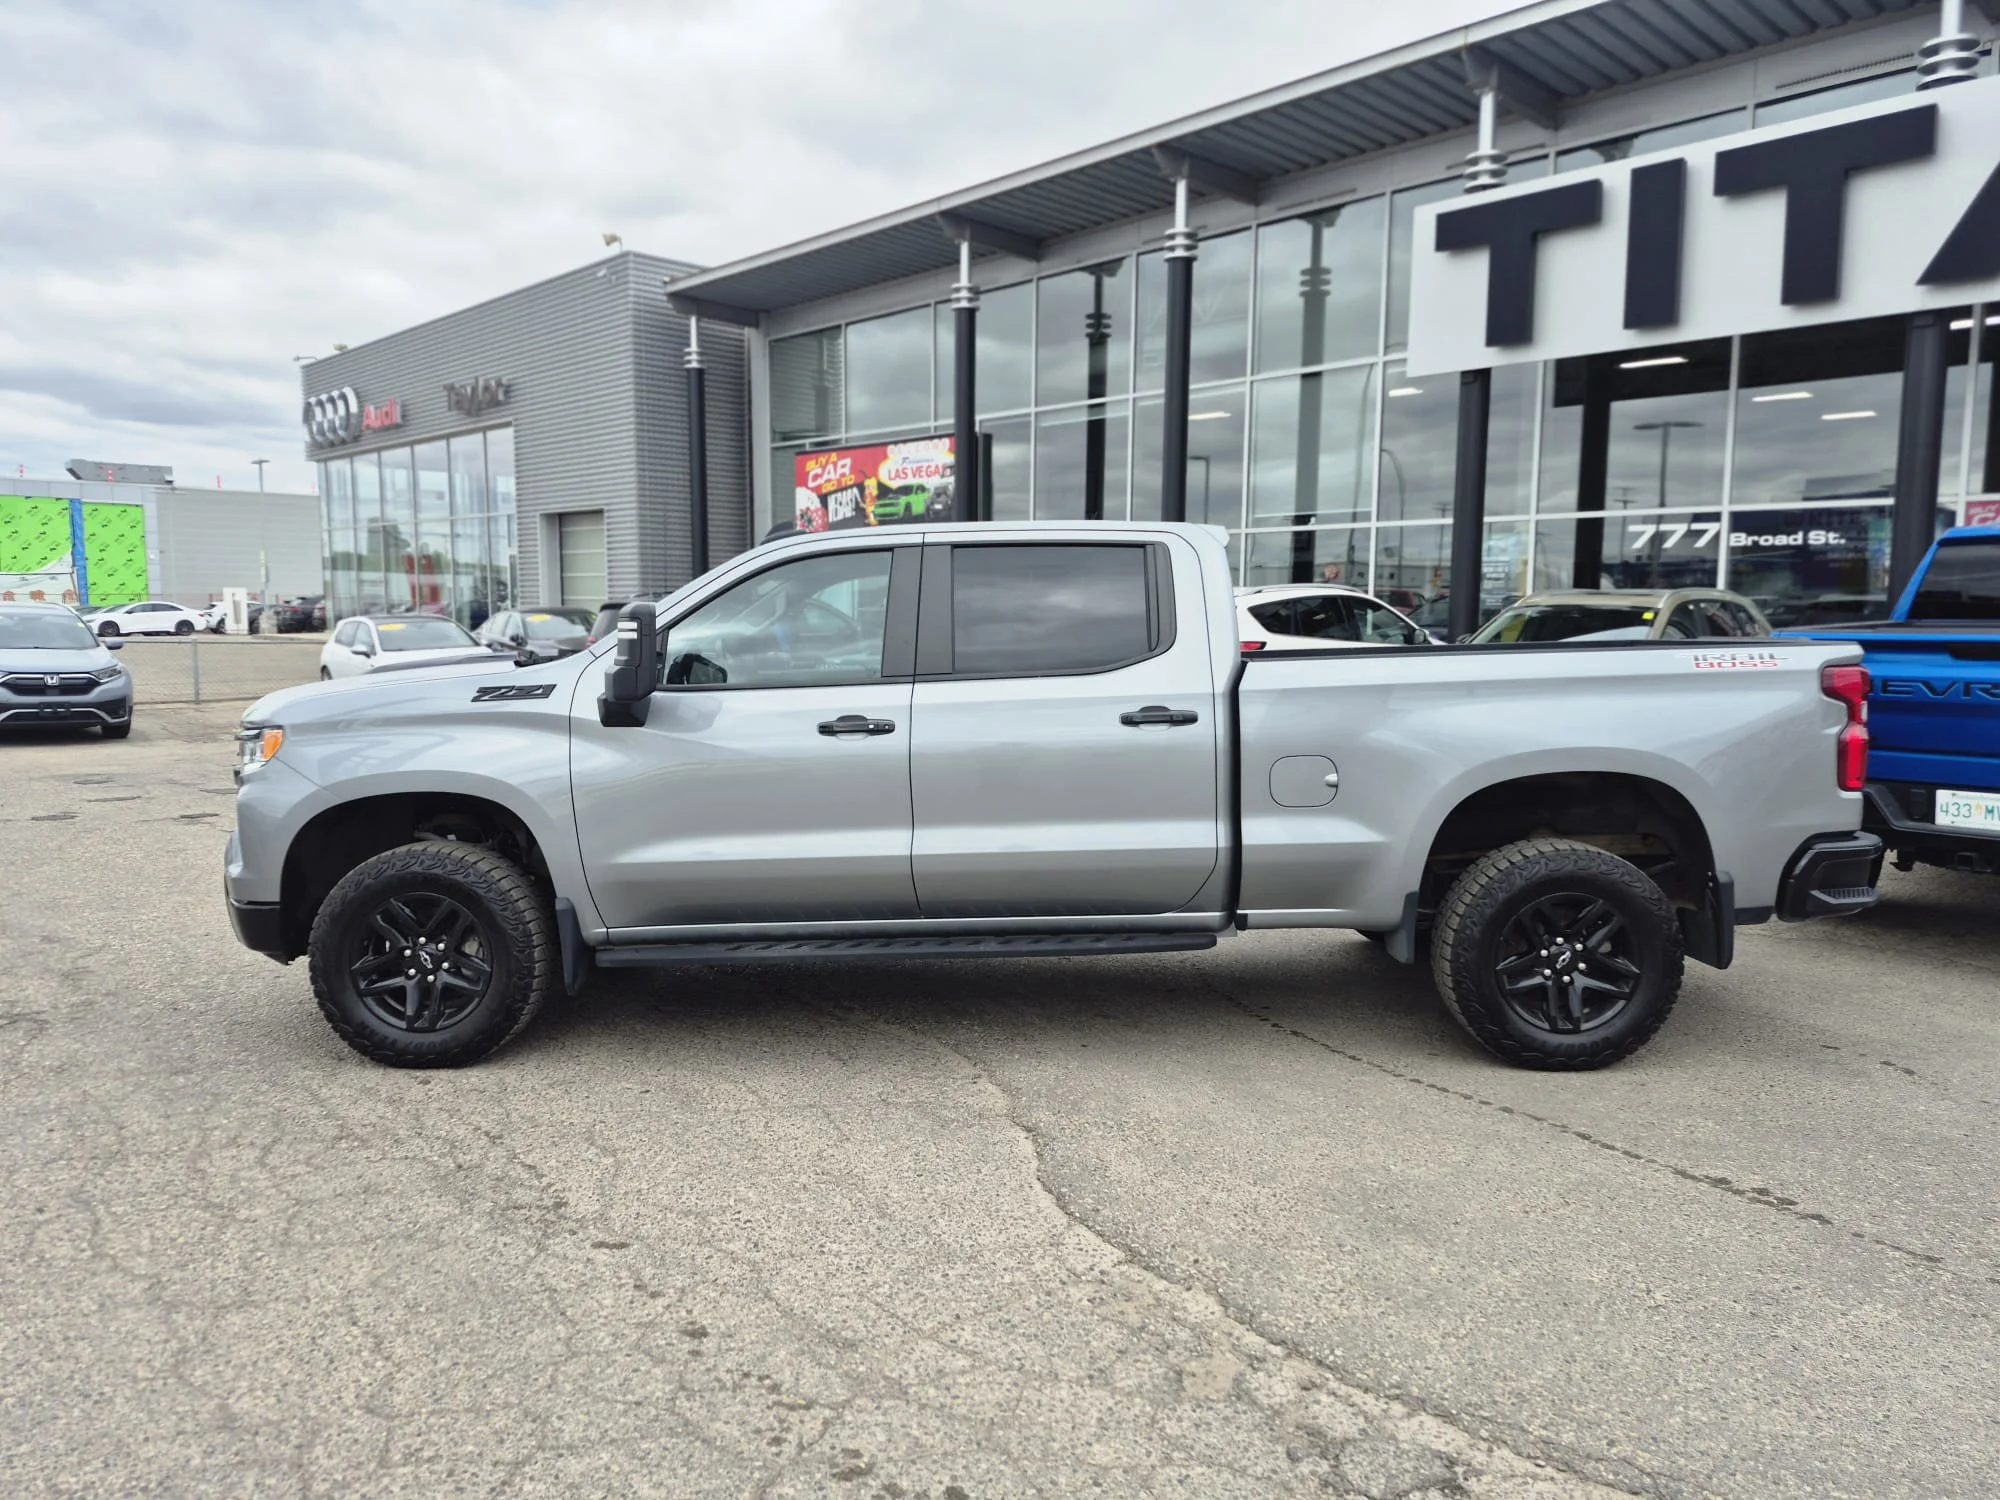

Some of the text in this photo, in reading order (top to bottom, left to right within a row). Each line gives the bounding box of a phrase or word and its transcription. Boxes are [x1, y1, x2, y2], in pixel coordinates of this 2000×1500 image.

[362, 396, 404, 432] Audi
[805, 452, 838, 472] BUY A
[808, 457, 852, 488] CAR
[888, 464, 945, 481] LAS VEGA
[821, 474, 856, 494] GO TO
[1627, 522, 1847, 550] 777 Broad St.
[1695, 660, 1778, 668] BOSS
[471, 684, 557, 702] Z71
[1940, 802, 2000, 822] 433 M
